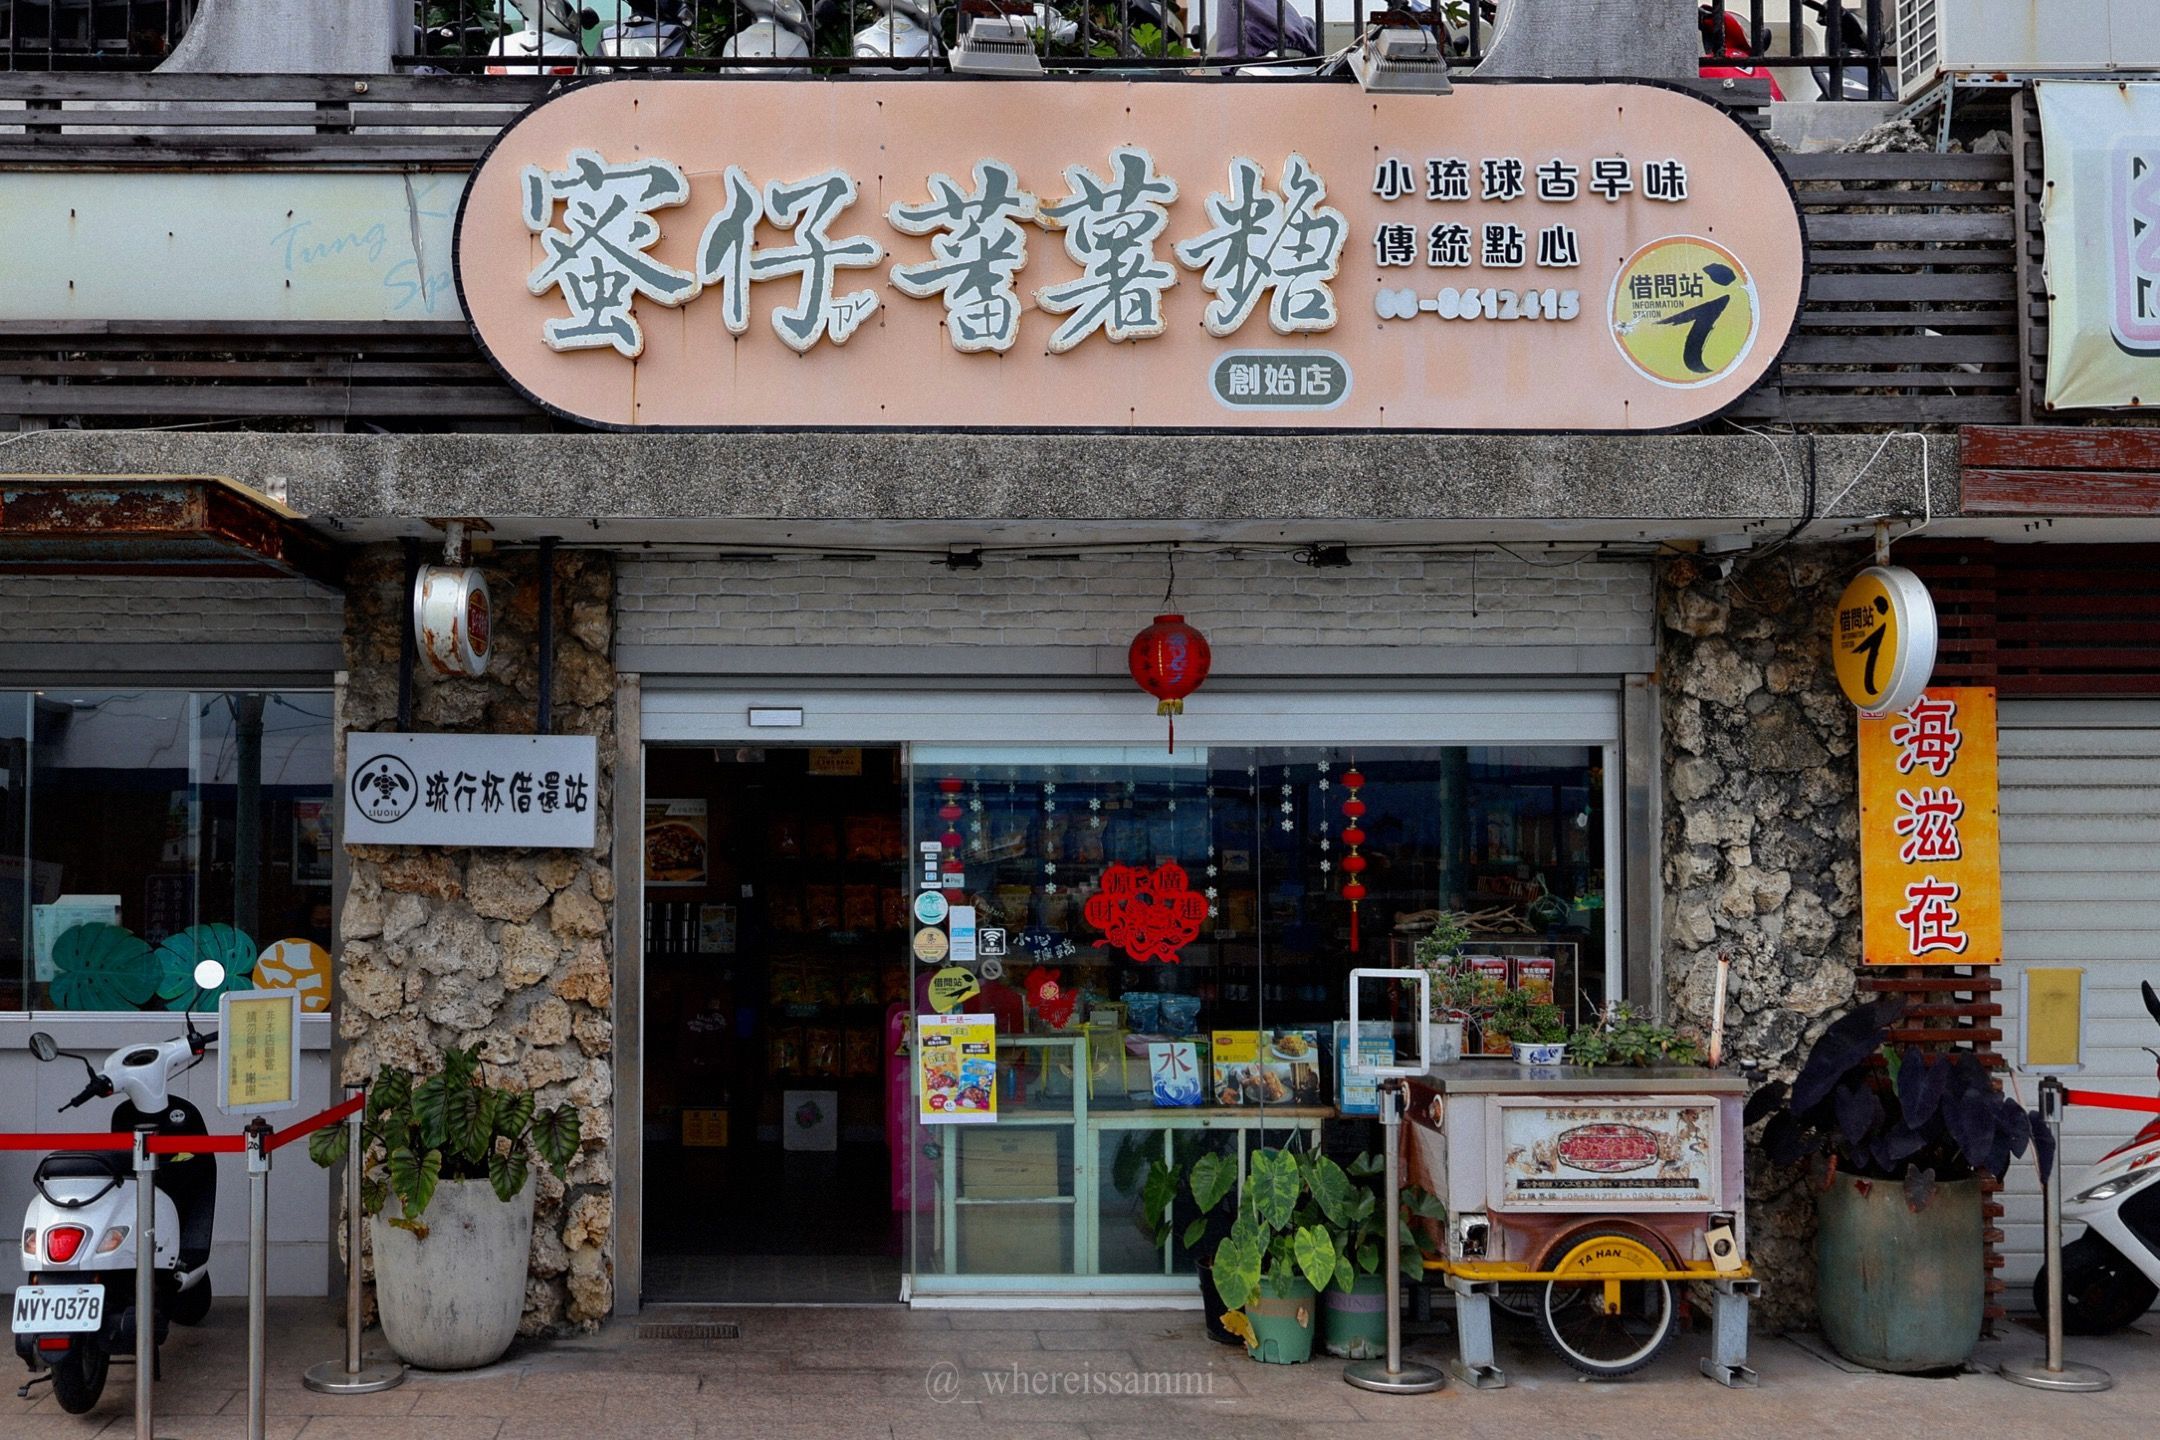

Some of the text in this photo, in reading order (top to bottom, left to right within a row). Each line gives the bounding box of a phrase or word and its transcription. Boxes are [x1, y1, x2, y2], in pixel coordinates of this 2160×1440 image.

[1375, 158, 1686, 200] 小琉球古早味
[524, 150, 1347, 350] 蜜仔蕃薯糖
[1376, 224, 1579, 267] 傳統點心
[1629, 273, 1703, 299] 借問站
[1632, 300, 1684, 309] INFORMATION
[1633, 310, 1661, 319] STATION
[1229, 364, 1332, 395] 創始店
[1840, 605, 1874, 633] 借問站
[425, 770, 588, 814] 琉行杯借還站
[1891, 696, 1966, 954] 海滋在
[1158, 1044, 1191, 1080] 水
[1578, 1249, 1621, 1267] TA HAN
